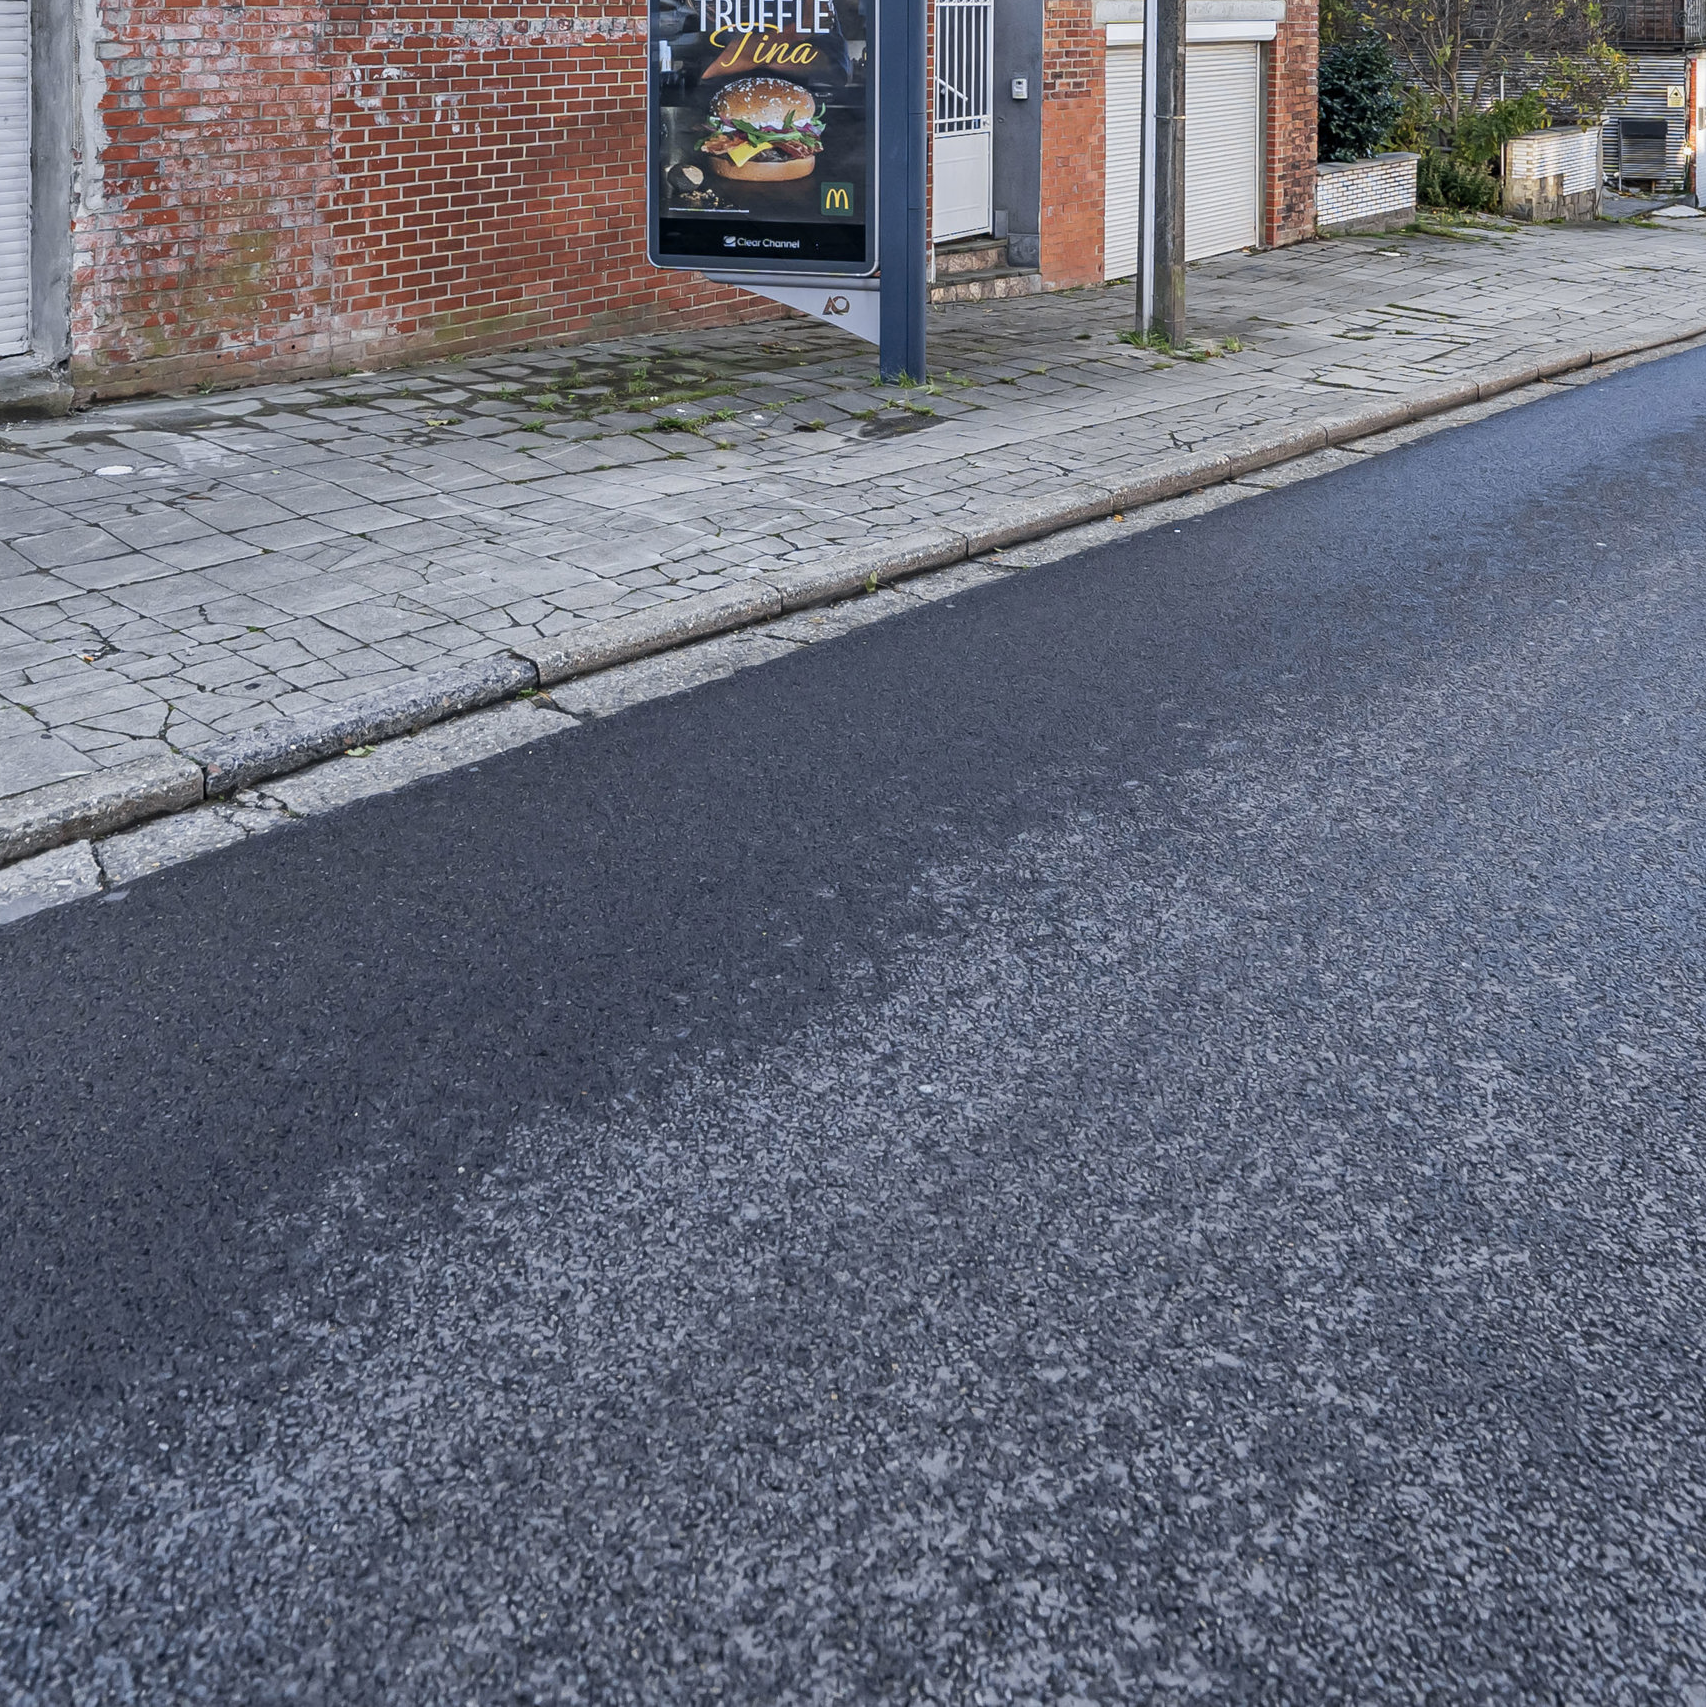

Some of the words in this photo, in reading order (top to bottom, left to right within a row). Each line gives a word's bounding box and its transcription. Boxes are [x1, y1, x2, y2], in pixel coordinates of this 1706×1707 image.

[709, 22, 819, 68] Tina
[736, 237, 762, 247] Clear
[762, 238, 800, 249] Channel
